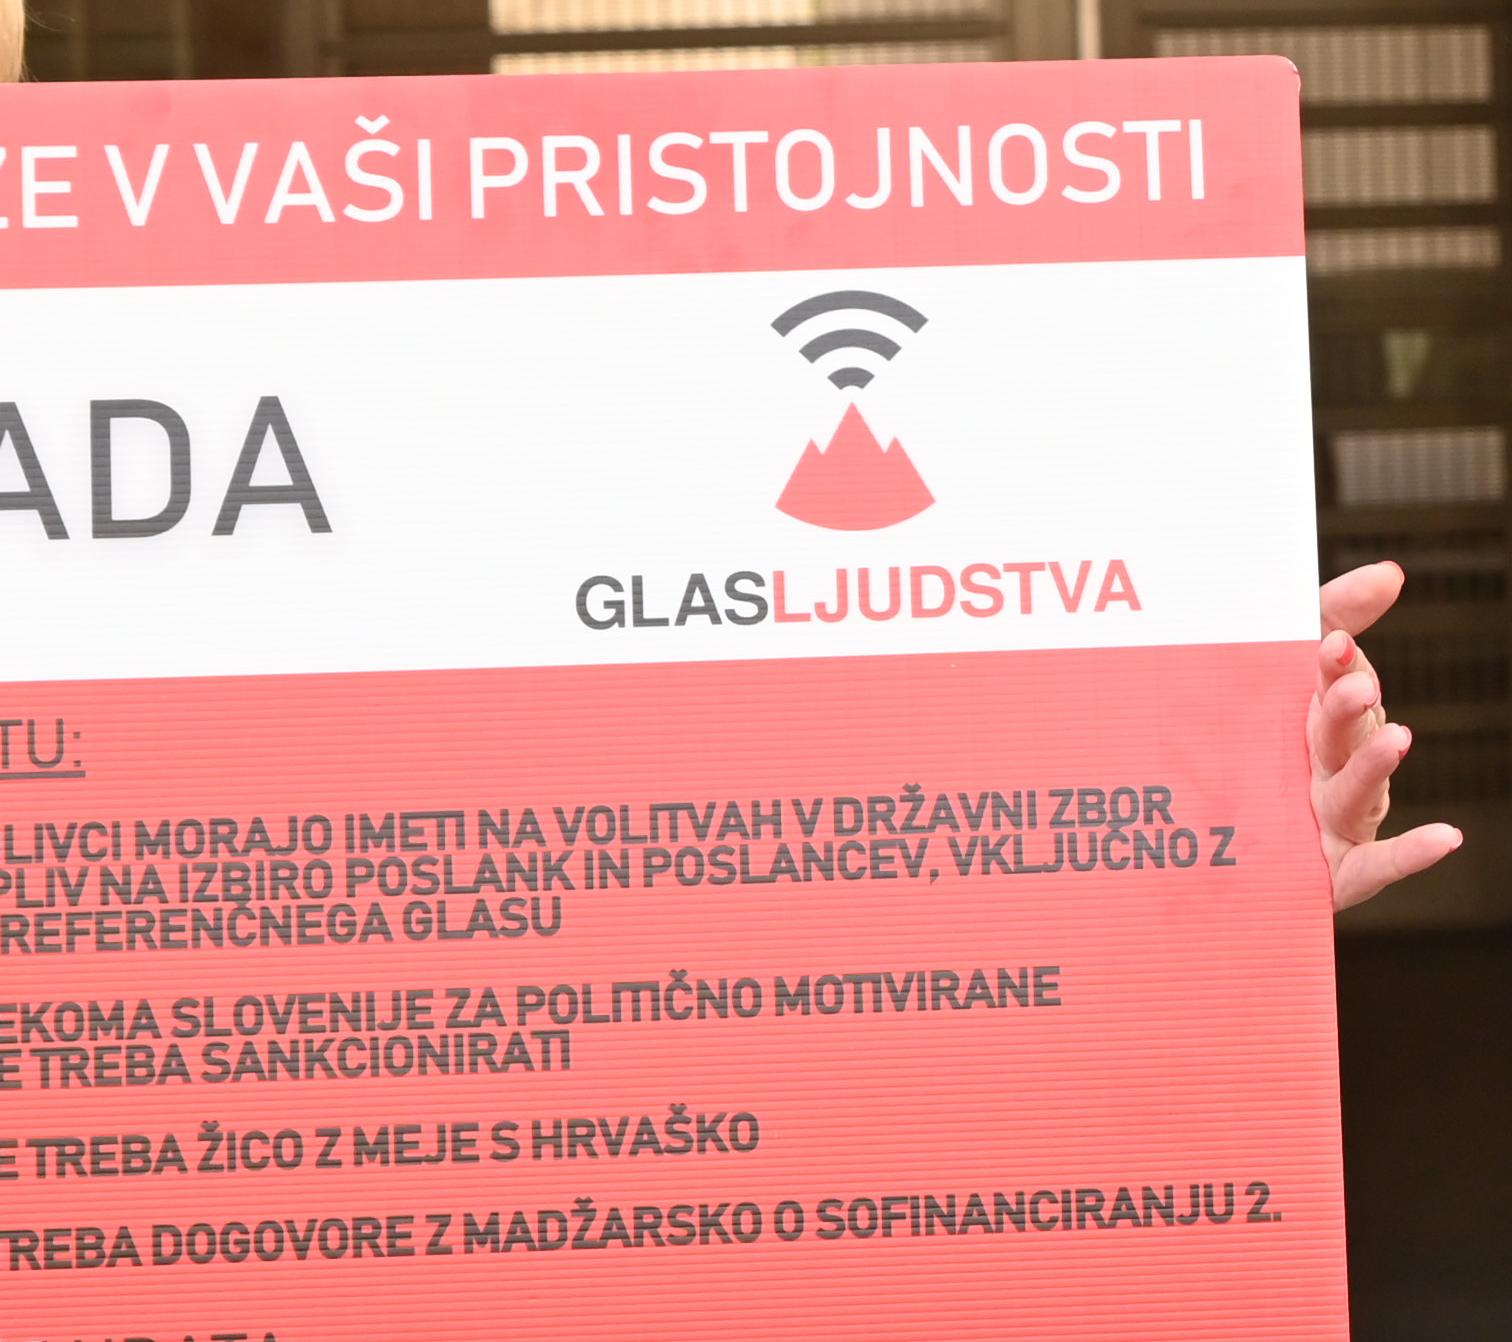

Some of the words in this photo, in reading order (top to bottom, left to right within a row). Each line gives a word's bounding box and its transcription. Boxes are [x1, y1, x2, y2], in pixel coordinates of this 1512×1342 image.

[104, 144, 169, 226] V
[194, 115, 432, 224] VAŠI
[470, 119, 1204, 218] PRISTOJNOSTI
[136, 816, 332, 859] MORAJO
[346, 811, 465, 852] IMETI
[479, 809, 546, 848] NA
[555, 801, 781, 845] VOLITVAH
[794, 799, 822, 836] V
[835, 785, 1037, 836] DRŽAVNI
[1050, 787, 1173, 829] ZBOR
[101, 866, 168, 905] NA
[180, 860, 332, 903] IZBIRO
[347, 851, 575, 897] POSLANK
[586, 850, 629, 889] IN
[644, 840, 938, 887] POSLANCEV,
[950, 820, 1197, 875] VKLJUČNO
[1211, 827, 1236, 866] Z
[404, 897, 561, 940] GLASU
[173, 991, 434, 1038] SLOVENIJE
[447, 989, 506, 1028] ZA
[518, 970, 762, 1025] POLITIČNO
[776, 967, 1061, 1016] MOTIVIRANE
[30, 1044, 191, 1087] TREBA
[203, 1029, 570, 1082] SANKCIONIRATI
[27, 1135, 187, 1178] TREBA
[198, 1121, 303, 1172] ŽICO
[317, 1129, 342, 1167] Z
[354, 1123, 479, 1165] MEJE
[492, 1122, 520, 1161] S
[533, 1104, 759, 1159] HRVAŠKO
[153, 1216, 414, 1265] DOGOVORE
[426, 1215, 452, 1255] Z
[464, 1198, 762, 1253] MADŽARSKO
[775, 1201, 804, 1241] O
[817, 1183, 1234, 1239] SOFINANCIRANJU
[1246, 1182, 1281, 1221] 2.
